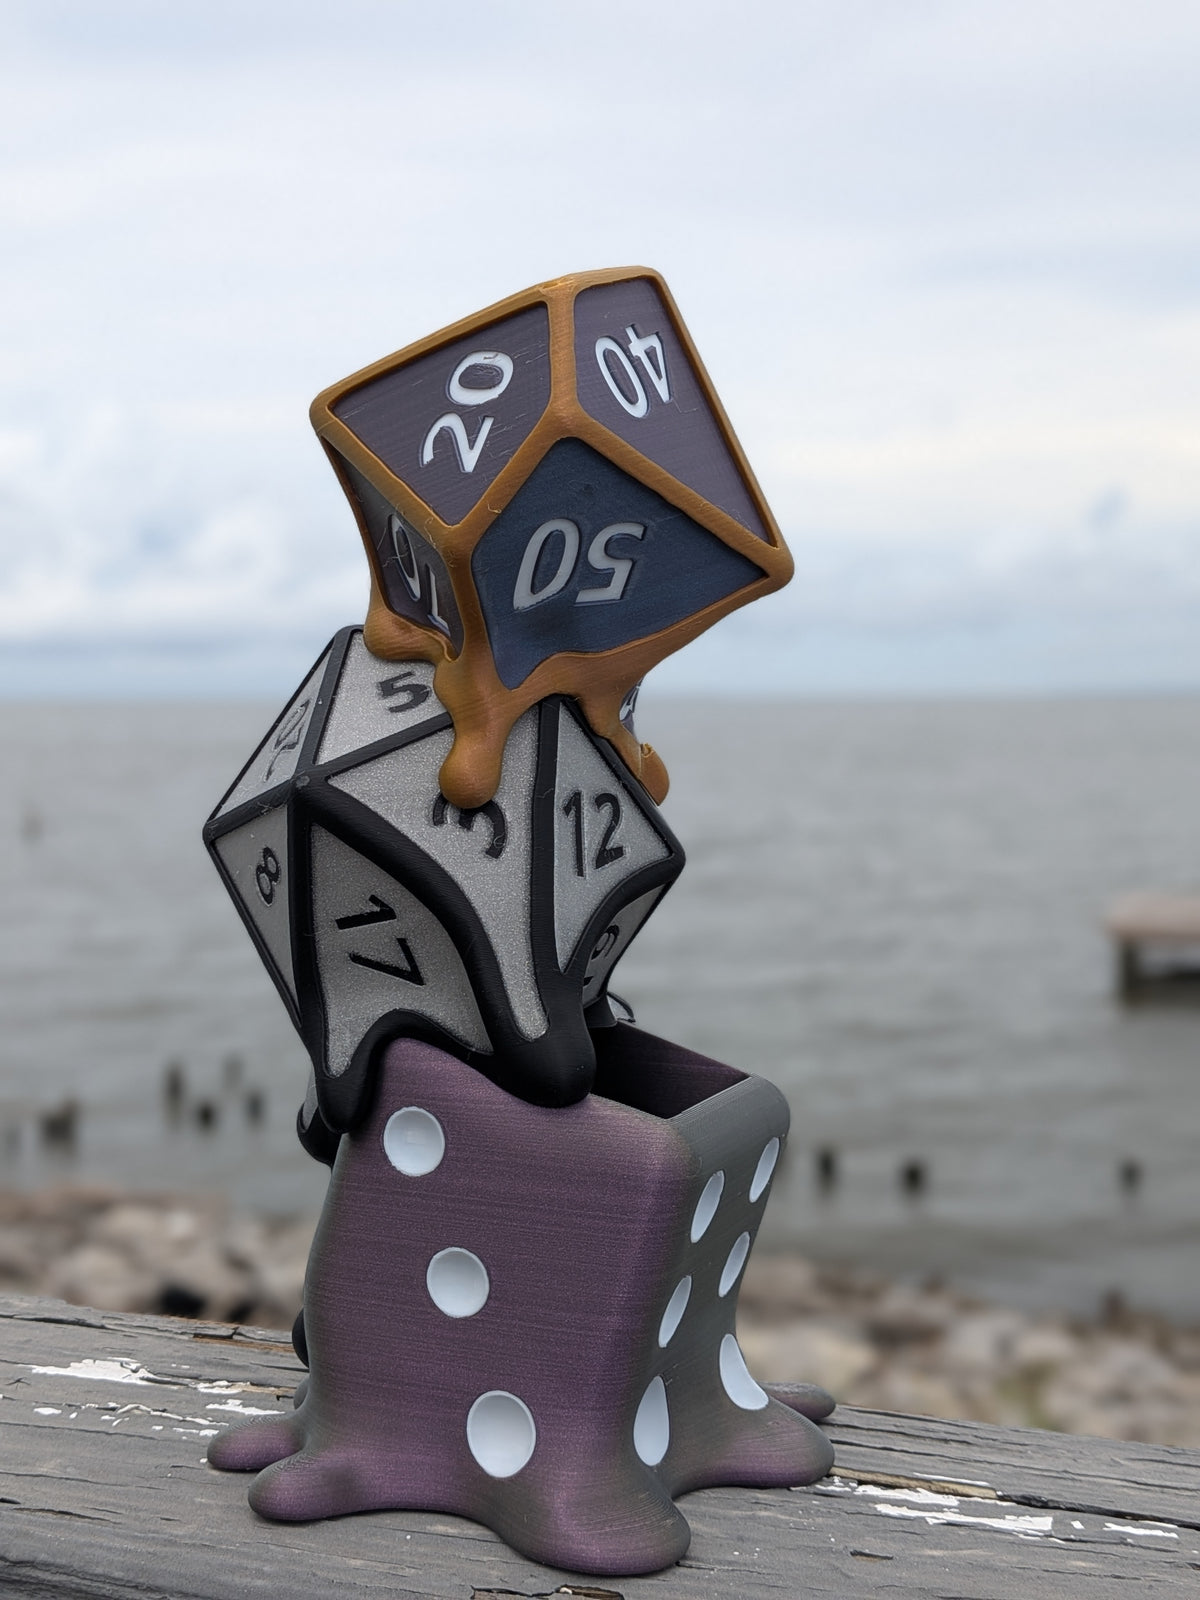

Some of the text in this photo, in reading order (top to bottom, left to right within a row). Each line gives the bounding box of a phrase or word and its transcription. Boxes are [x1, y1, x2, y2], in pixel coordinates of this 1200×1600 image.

[419, 350, 514, 474] 20
[594, 323, 672, 419] 40
[387, 512, 451, 637] 10
[512, 517, 648, 612] 50
[378, 671, 432, 714] 5
[256, 846, 281, 906] 8
[562, 789, 626, 878] 12
[334, 894, 426, 987] 17
